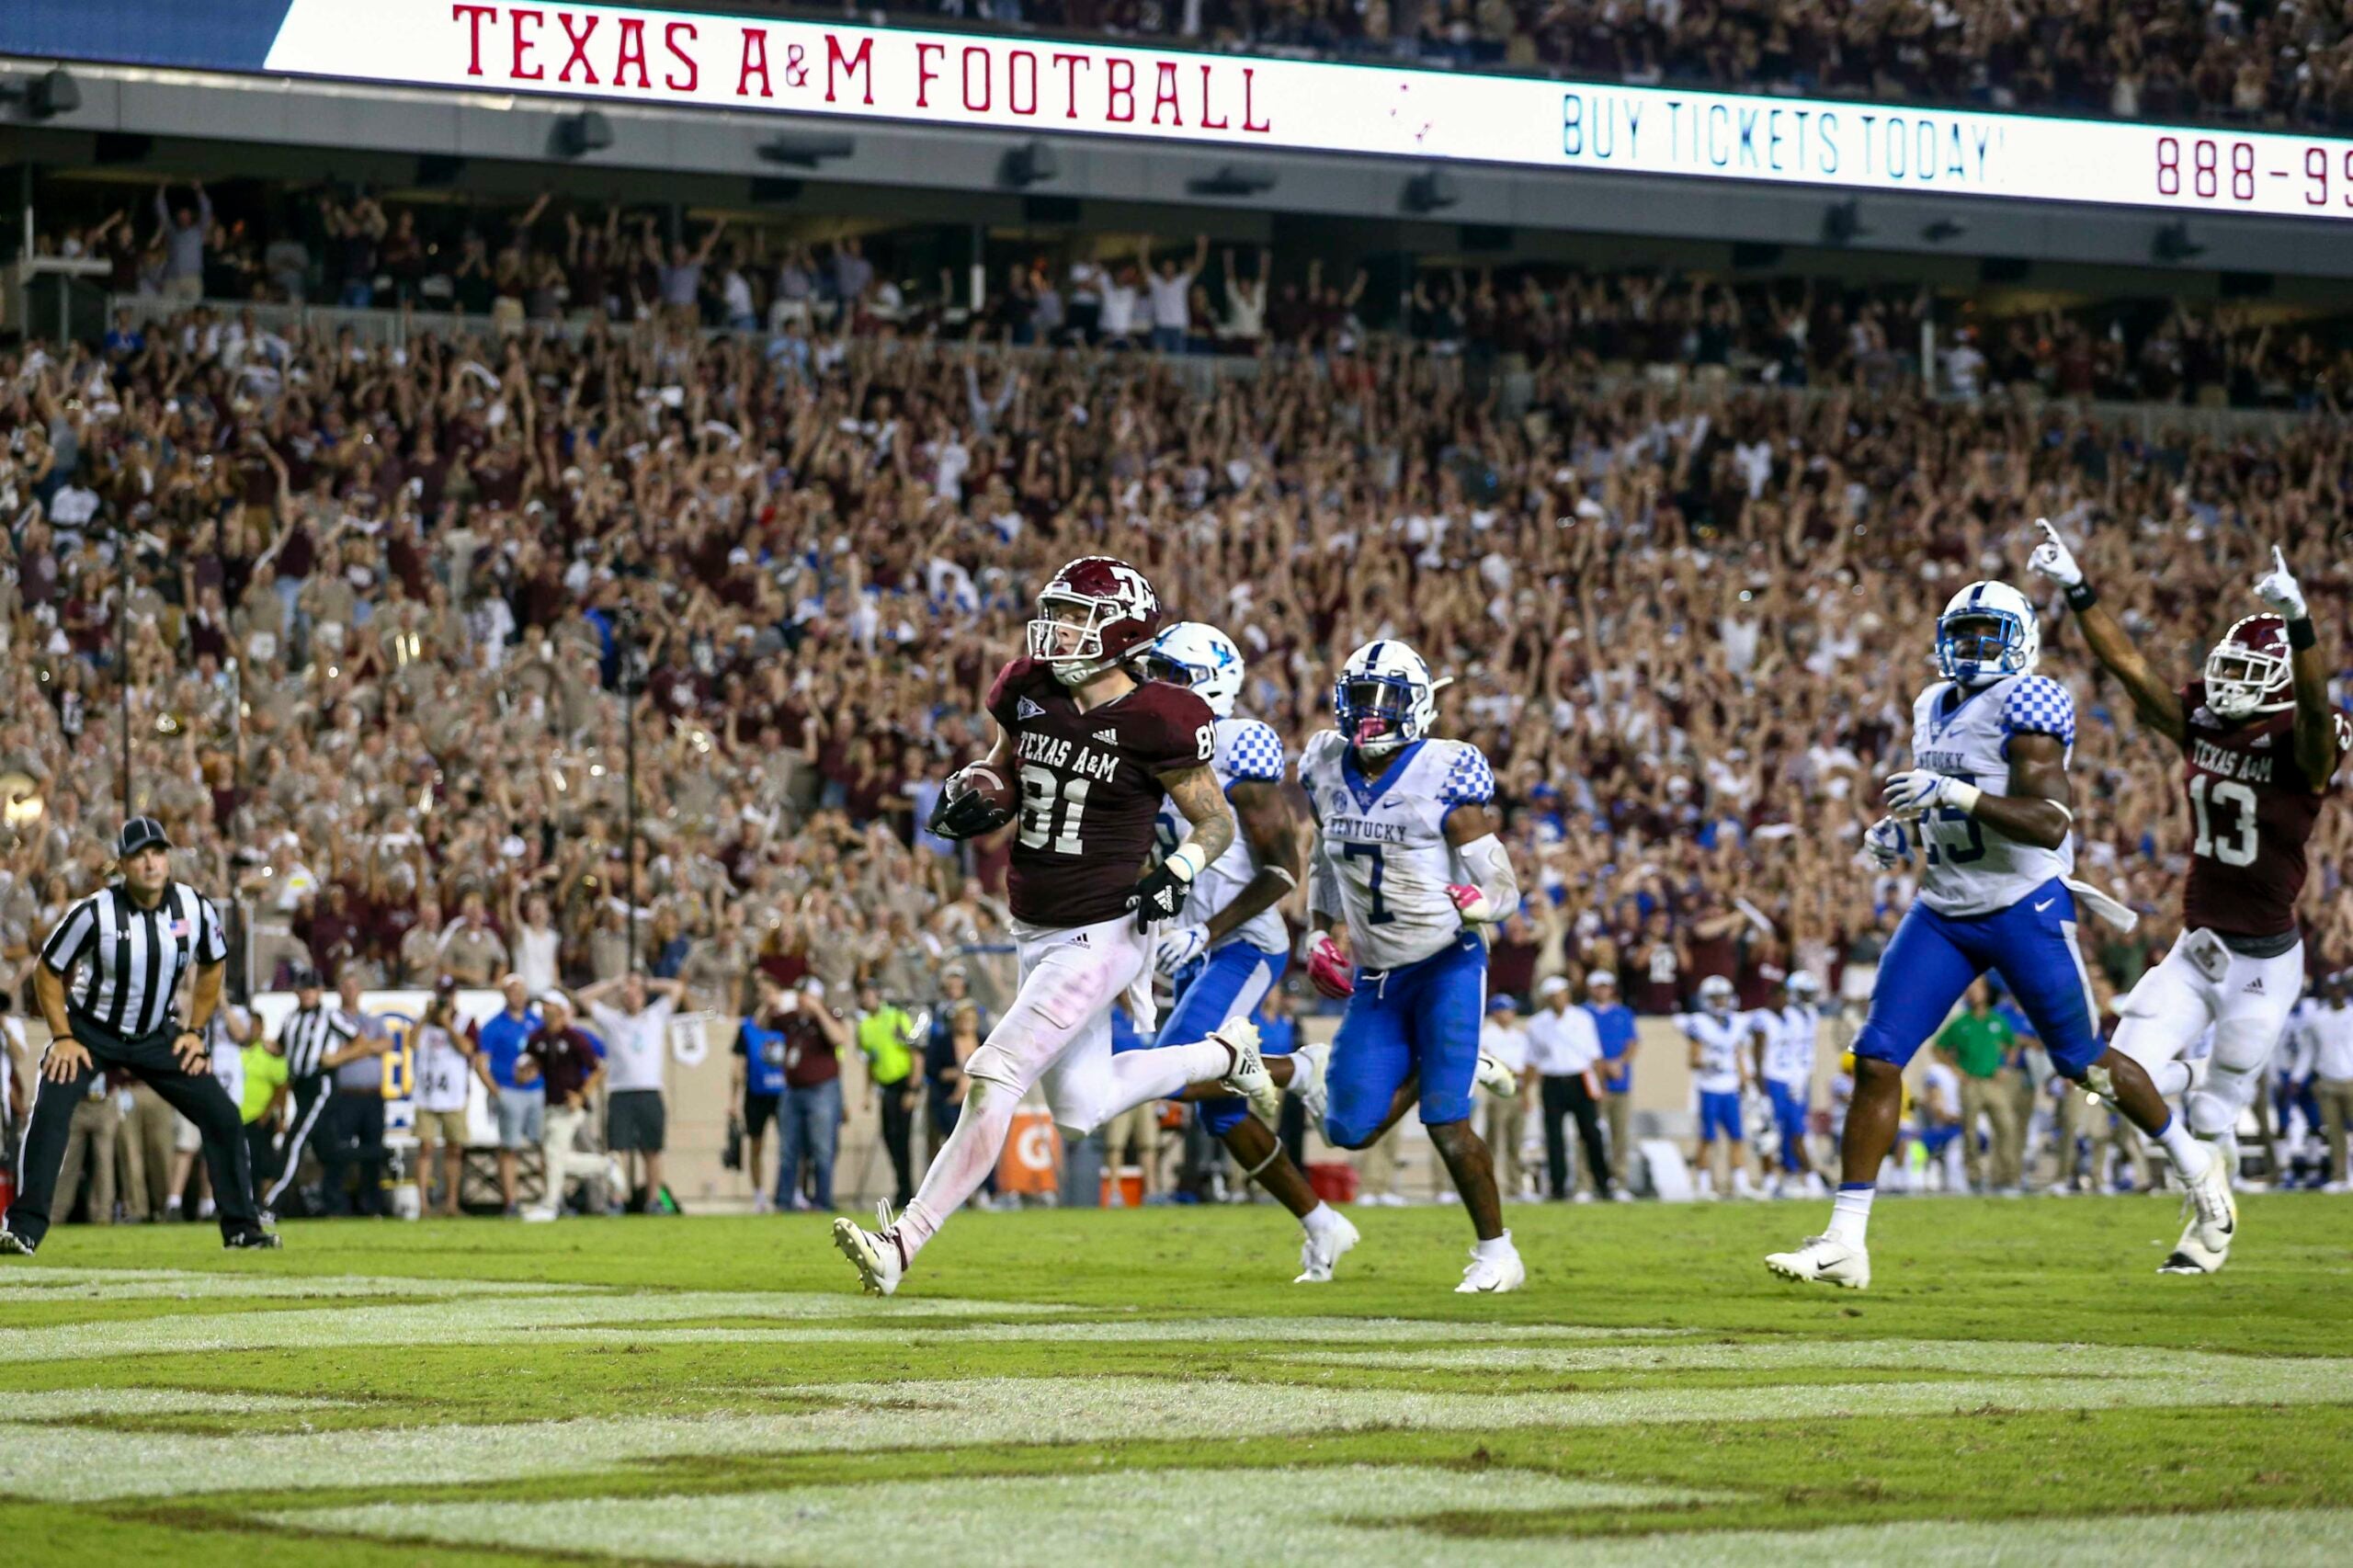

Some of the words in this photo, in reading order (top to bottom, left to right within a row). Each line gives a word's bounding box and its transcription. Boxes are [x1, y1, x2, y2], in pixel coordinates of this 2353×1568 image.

[452, 4, 699, 91] TEXAS
[736, 28, 874, 106] A&M
[915, 41, 1271, 133] FOOTBALL
[1563, 94, 1643, 160] BUY
[1667, 101, 1838, 175] TICKETS
[1017, 730, 1073, 767] TEXAS
[1071, 745, 1120, 783] A&M
[2191, 736, 2238, 776] TEXAS
[2236, 755, 2273, 783] A&M
[1019, 765, 1090, 855] 81
[1329, 816, 1407, 842] KENTUCKY
[2189, 773, 2258, 868] 13
[1344, 841, 1397, 926] 7
[1017, 1123, 1054, 1170] G
